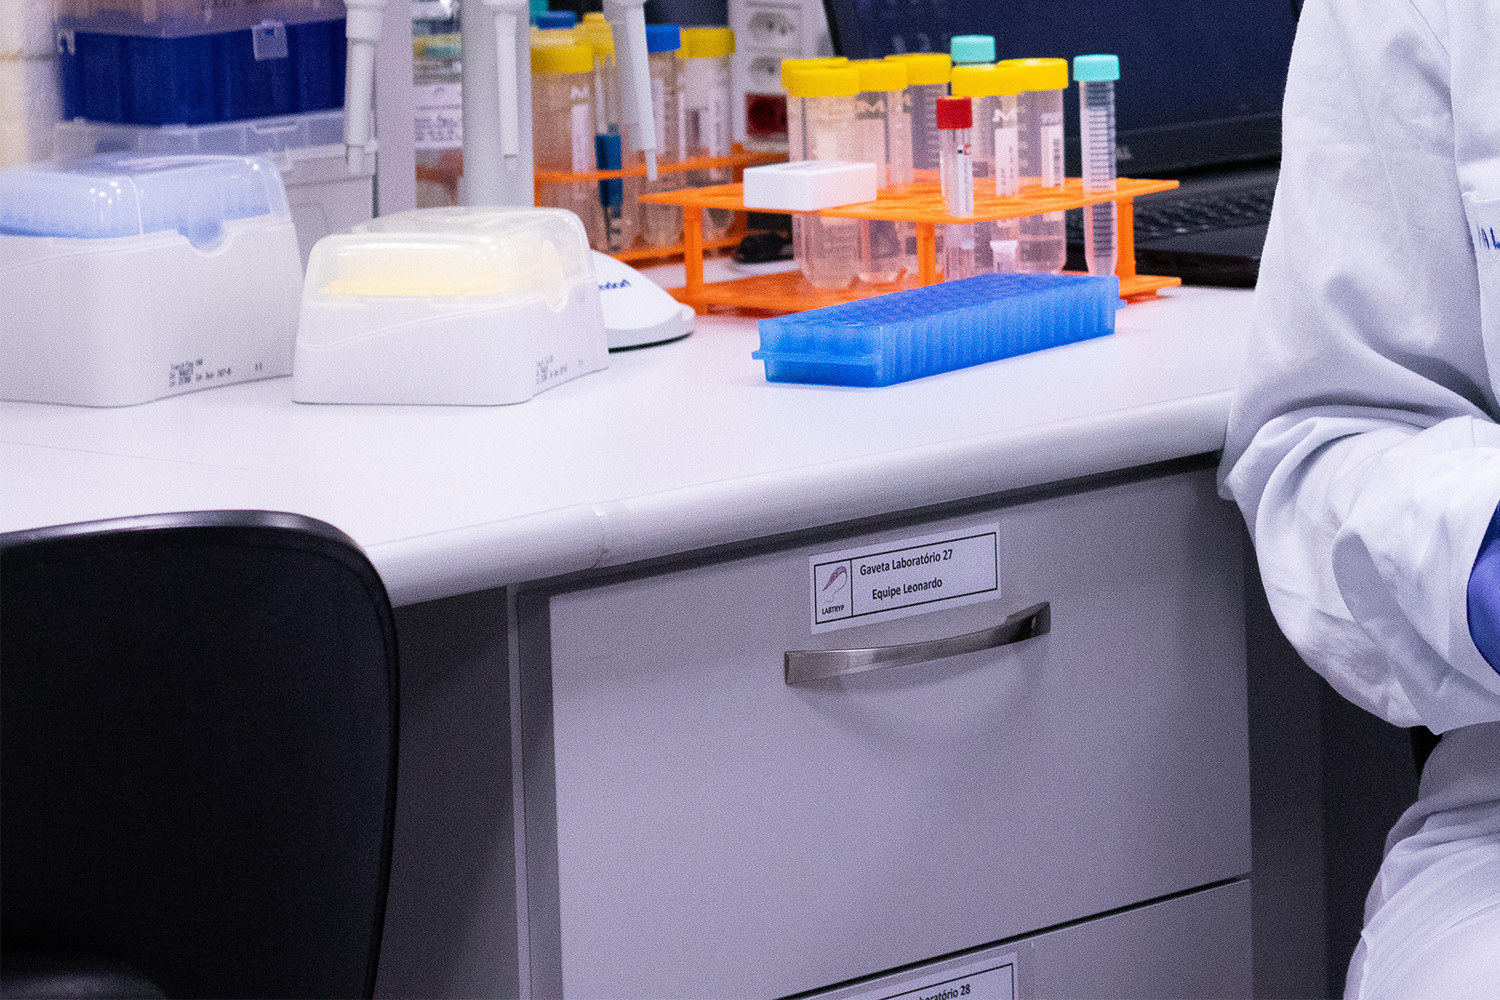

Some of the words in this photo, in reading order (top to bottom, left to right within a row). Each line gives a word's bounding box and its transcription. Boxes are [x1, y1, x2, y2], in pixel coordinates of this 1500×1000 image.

[859, 562, 890, 576] Gaveta
[891, 552, 941, 571] Laboratório
[942, 549, 953, 561] 27
[872, 585, 901, 601] Equipe
[903, 577, 943, 595] Leonardo
[960, 983, 971, 995] 28
